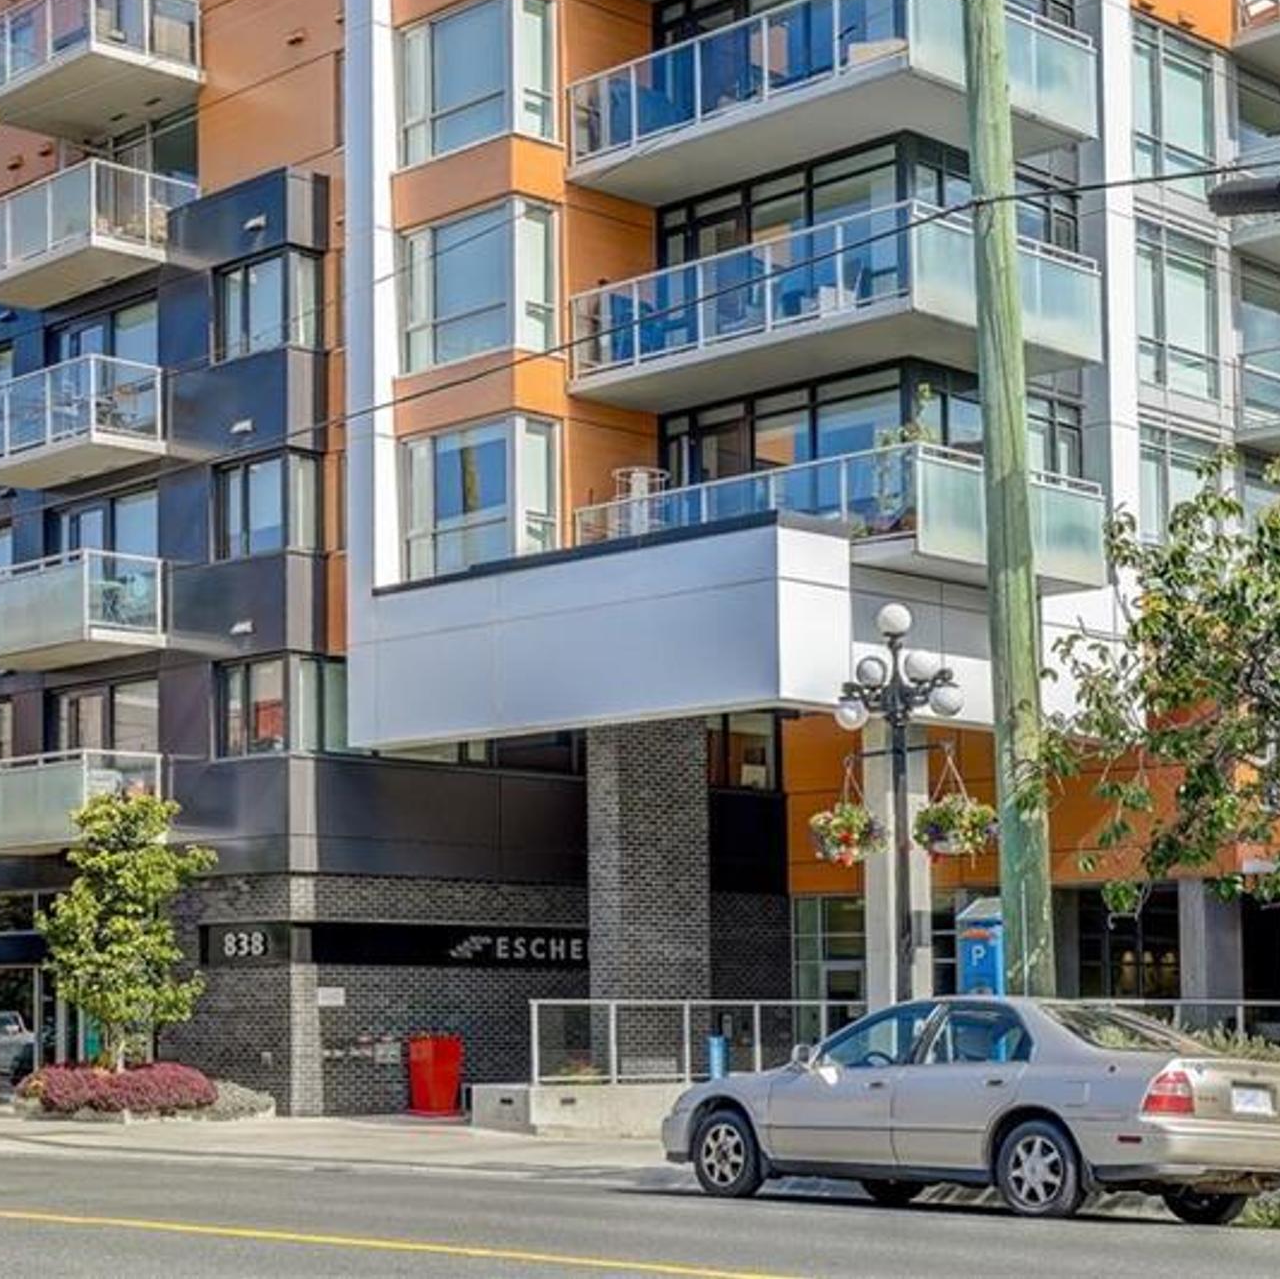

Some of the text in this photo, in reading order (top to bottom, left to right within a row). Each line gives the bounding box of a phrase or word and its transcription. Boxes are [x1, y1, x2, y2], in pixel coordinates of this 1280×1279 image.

[223, 932, 265, 957] 838
[496, 936, 588, 960] ESCHE
[971, 945, 986, 967] P
